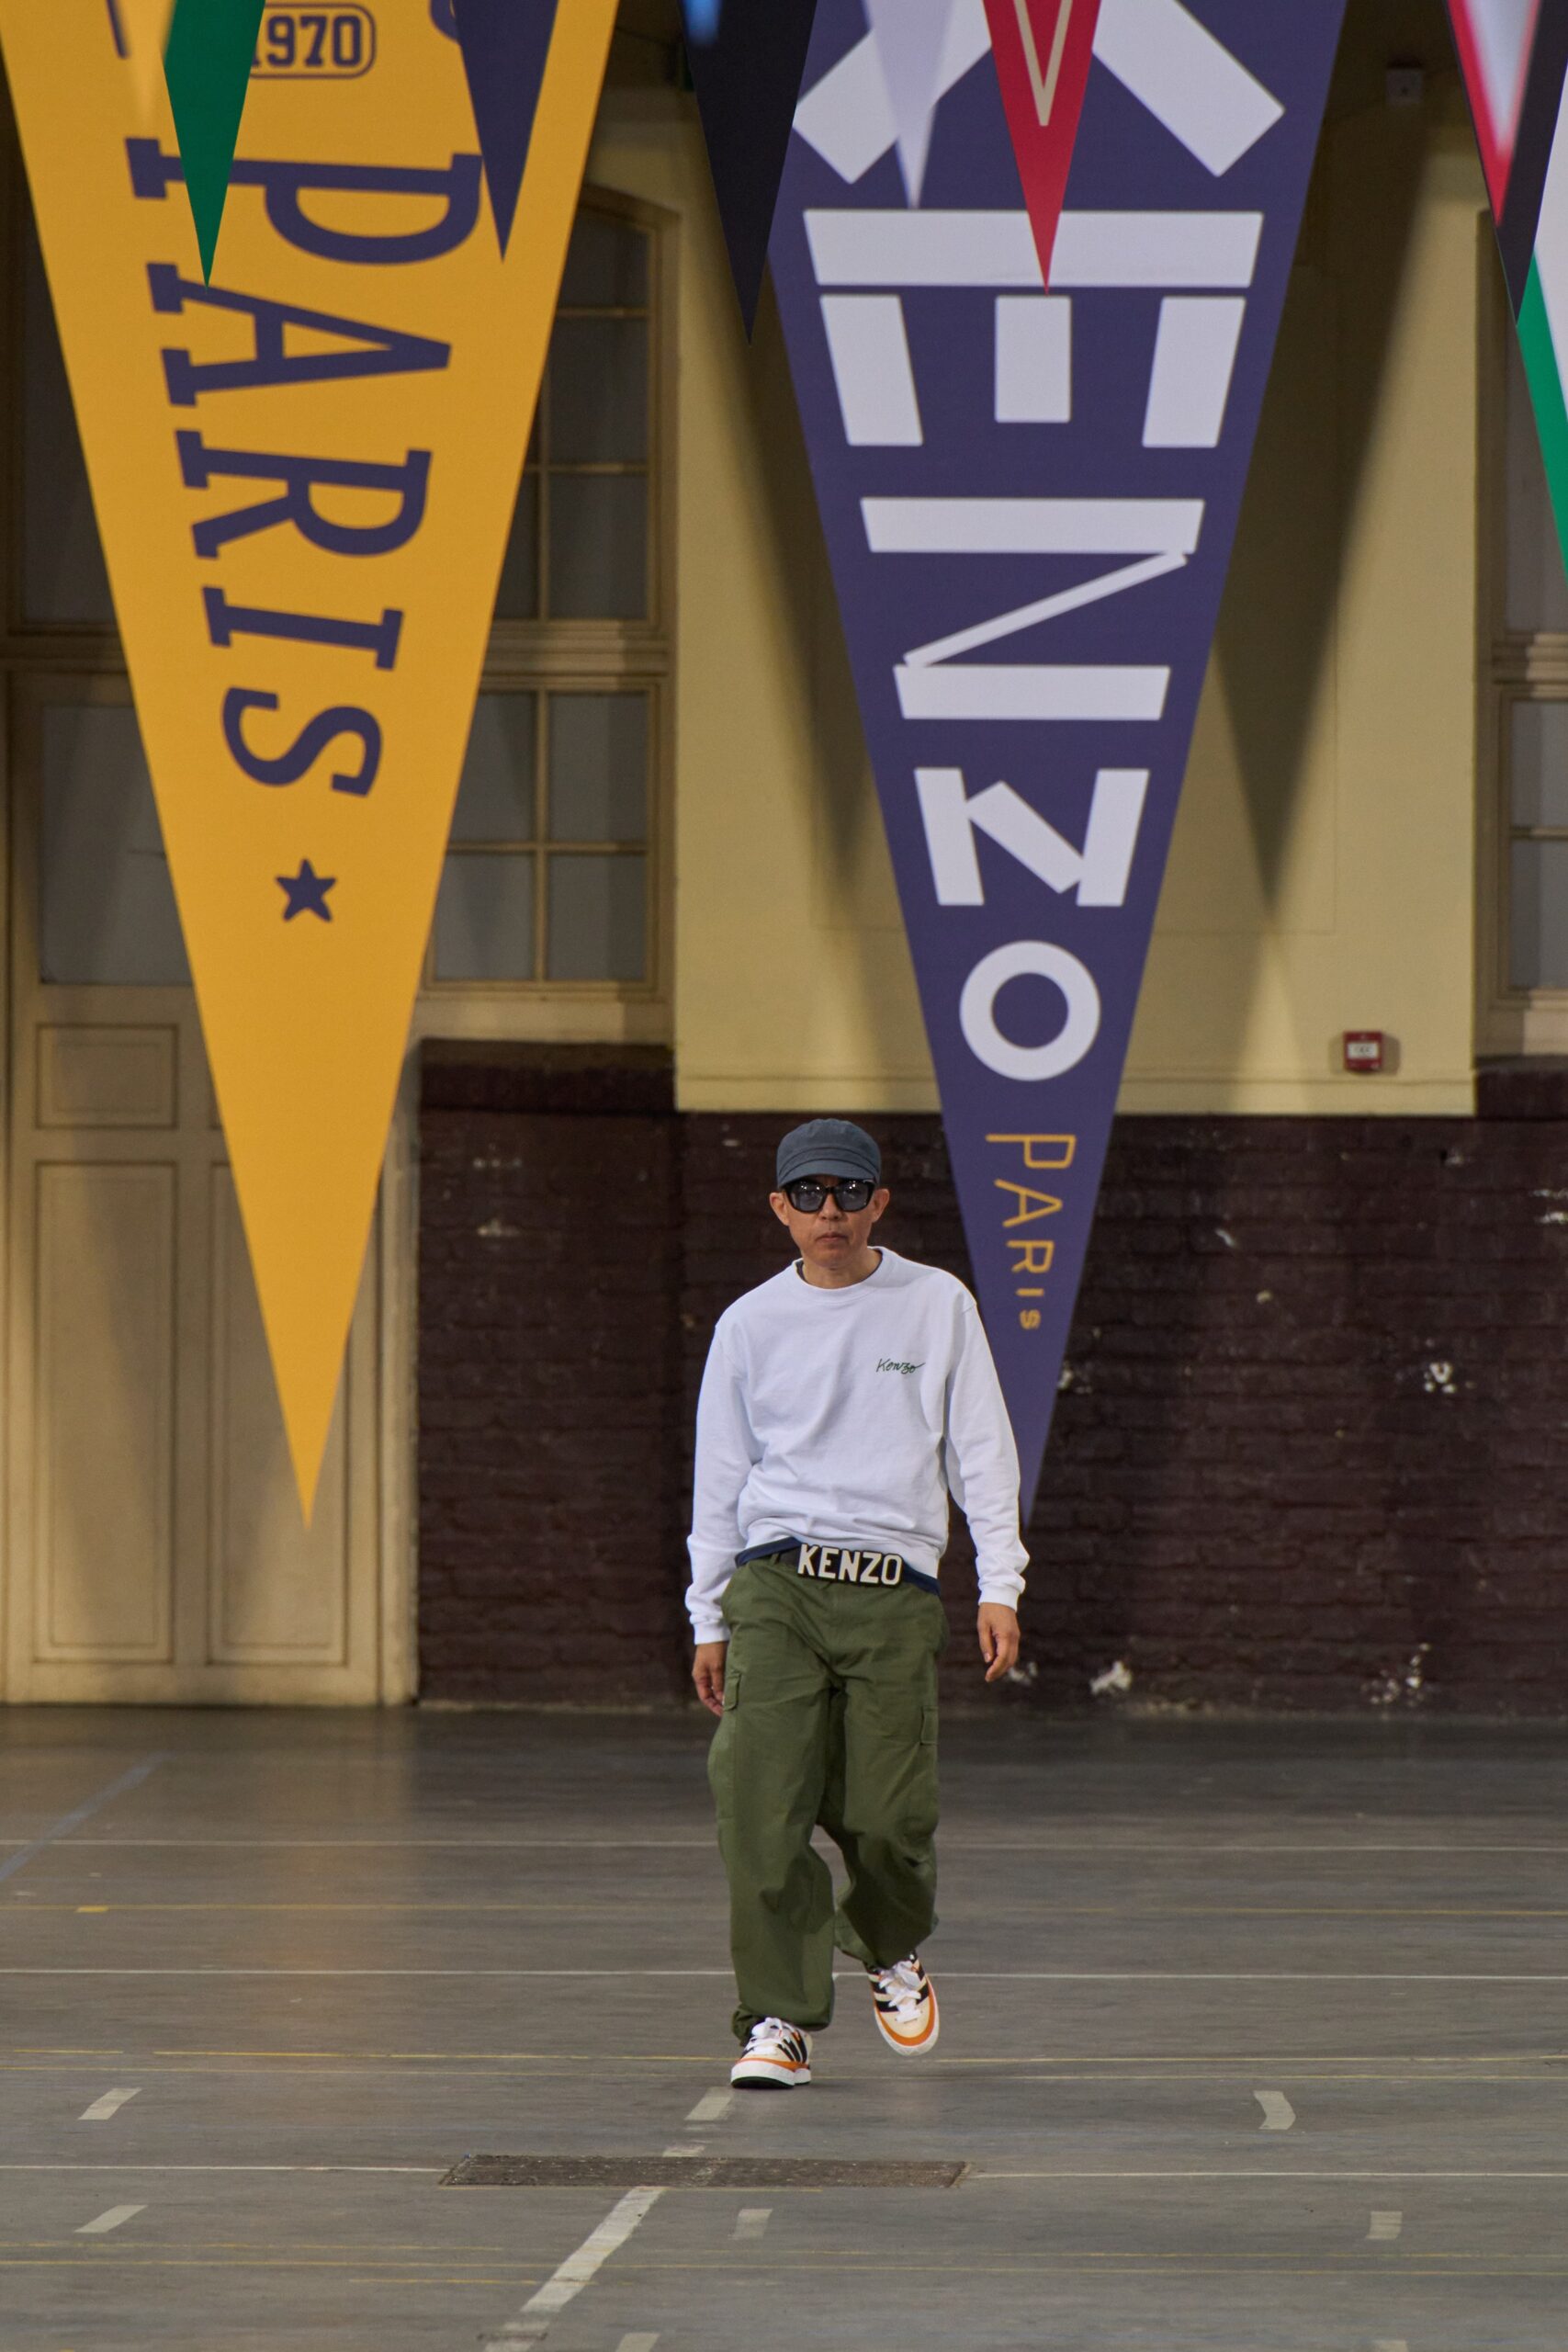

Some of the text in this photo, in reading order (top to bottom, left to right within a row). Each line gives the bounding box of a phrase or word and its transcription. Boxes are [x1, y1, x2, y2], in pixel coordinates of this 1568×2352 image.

[252, 15, 362, 66] 970
[124, 137, 483, 797] PARIS
[986, 1134, 1077, 1329] PARIS
[875, 1358, 926, 1374] Kenzo
[797, 1544, 903, 1586] KENZO
